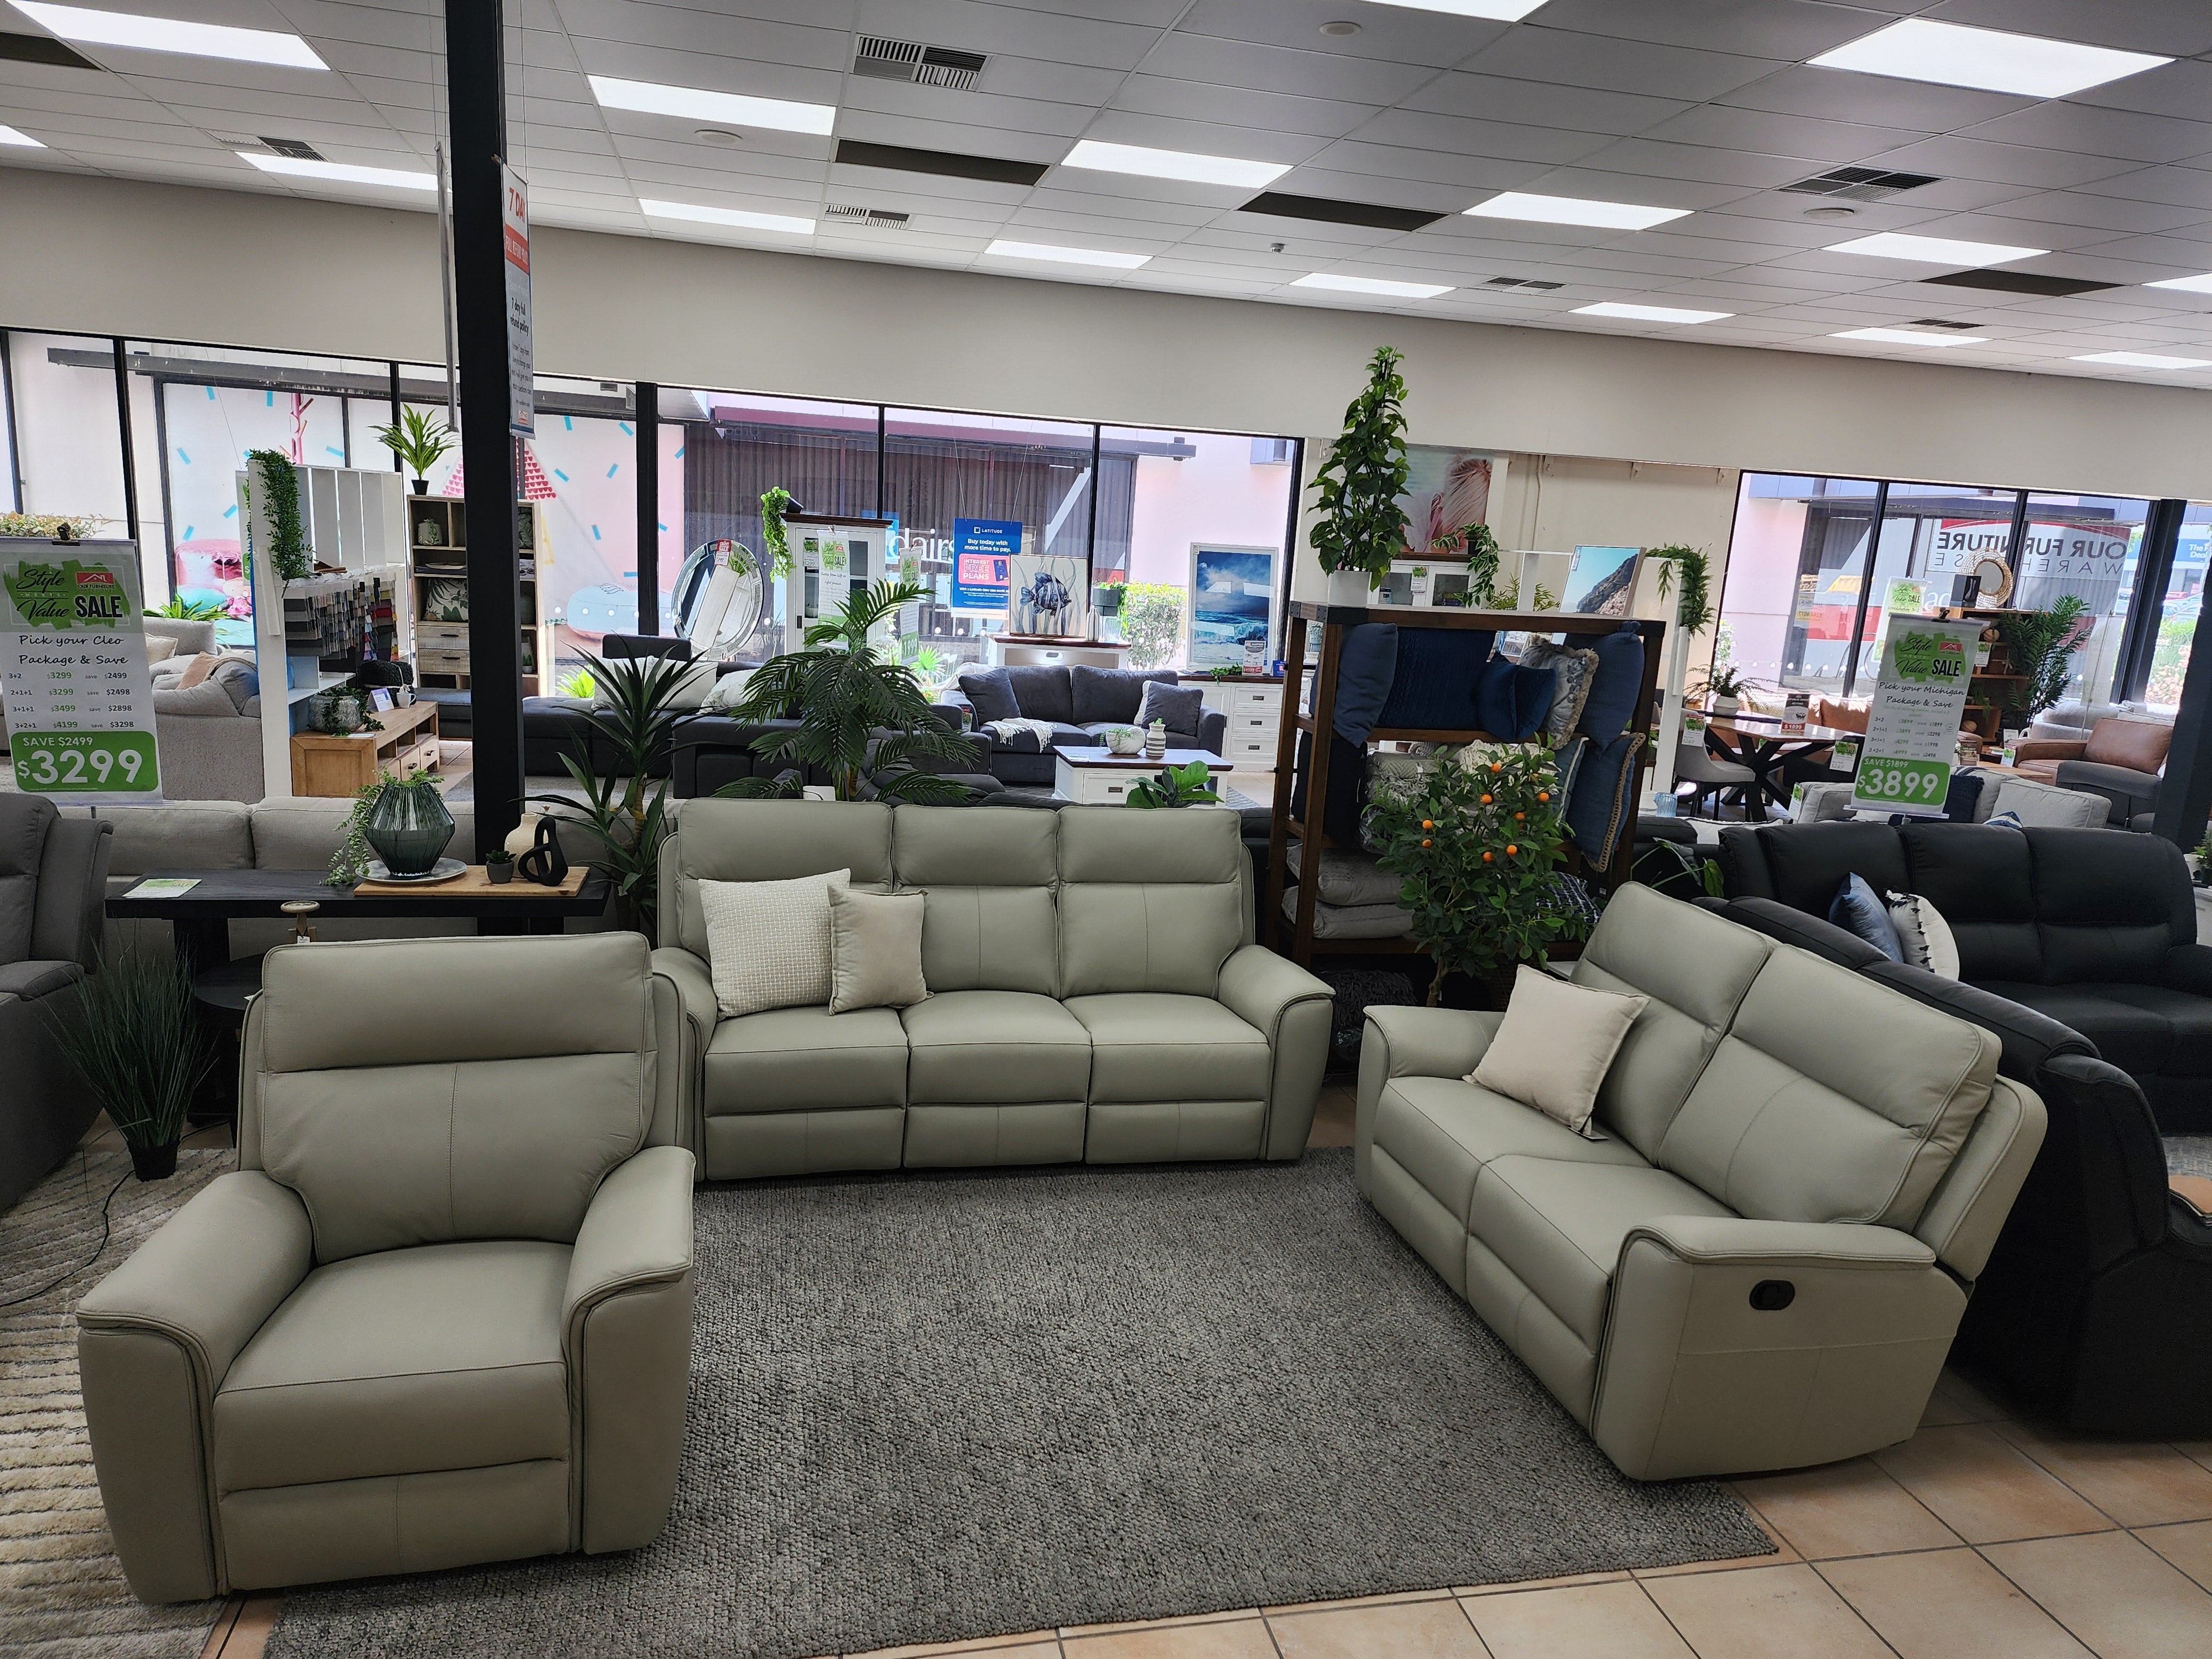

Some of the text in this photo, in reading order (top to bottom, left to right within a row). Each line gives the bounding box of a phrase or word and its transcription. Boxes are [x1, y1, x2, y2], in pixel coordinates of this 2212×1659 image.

[509, 187, 525, 224] 7 DAY
[834, 556, 845, 566] SALE
[964, 564, 989, 573] FREE
[16, 569, 65, 593] Style
[1908, 594, 1921, 603] SALE
[17, 598, 70, 620] Value
[75, 596, 123, 618] SALE
[19, 635, 124, 647] Pick your Cleo
[1901, 638, 1932, 655] Style
[19, 654, 129, 666] Package & Save
[1895, 659, 1926, 675] Value
[1932, 659, 1962, 677] SALE
[1879, 681, 1901, 691] Pick
[1923, 685, 1965, 697] Michigan
[1886, 695, 1921, 707] Package
[1933, 700, 1953, 708] Save
[23, 737, 93, 747] SAVE $2499
[17, 749, 143, 784] $3299
[1864, 758, 1885, 766] SAVE
[1886, 759, 1909, 768] $1899
[1858, 769, 1939, 799] $3899
